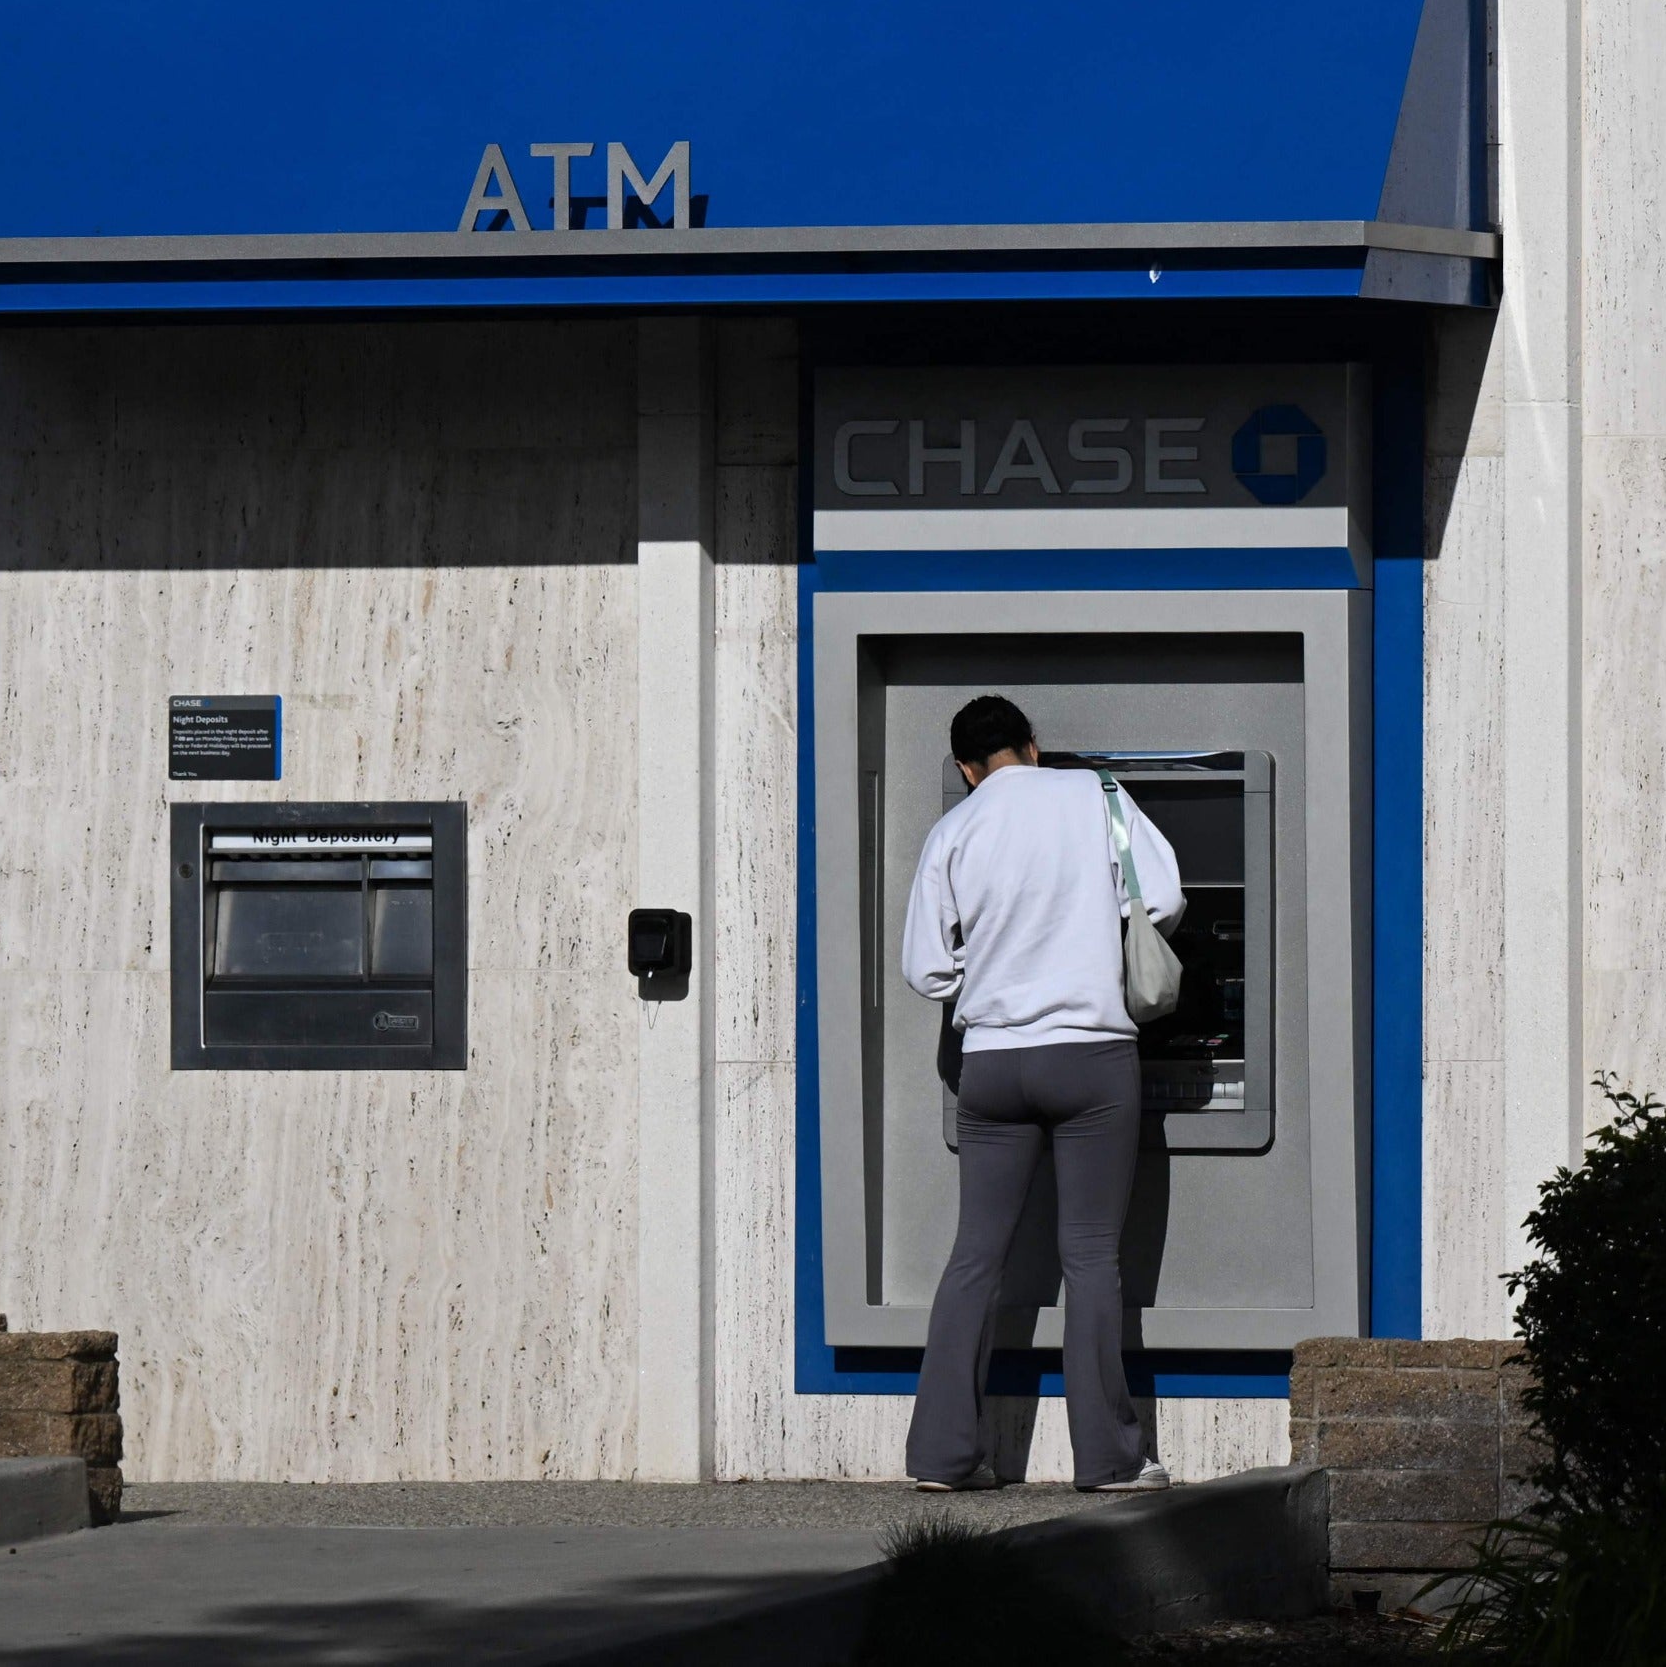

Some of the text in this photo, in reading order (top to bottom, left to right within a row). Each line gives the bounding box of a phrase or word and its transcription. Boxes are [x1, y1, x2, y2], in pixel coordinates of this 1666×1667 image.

[457, 141, 690, 232] ATM
[833, 417, 1208, 496] CHASE
[173, 699, 202, 707] CHASE
[173, 715, 229, 725] Night Deposits
[253, 829, 400, 846] Night Depository
